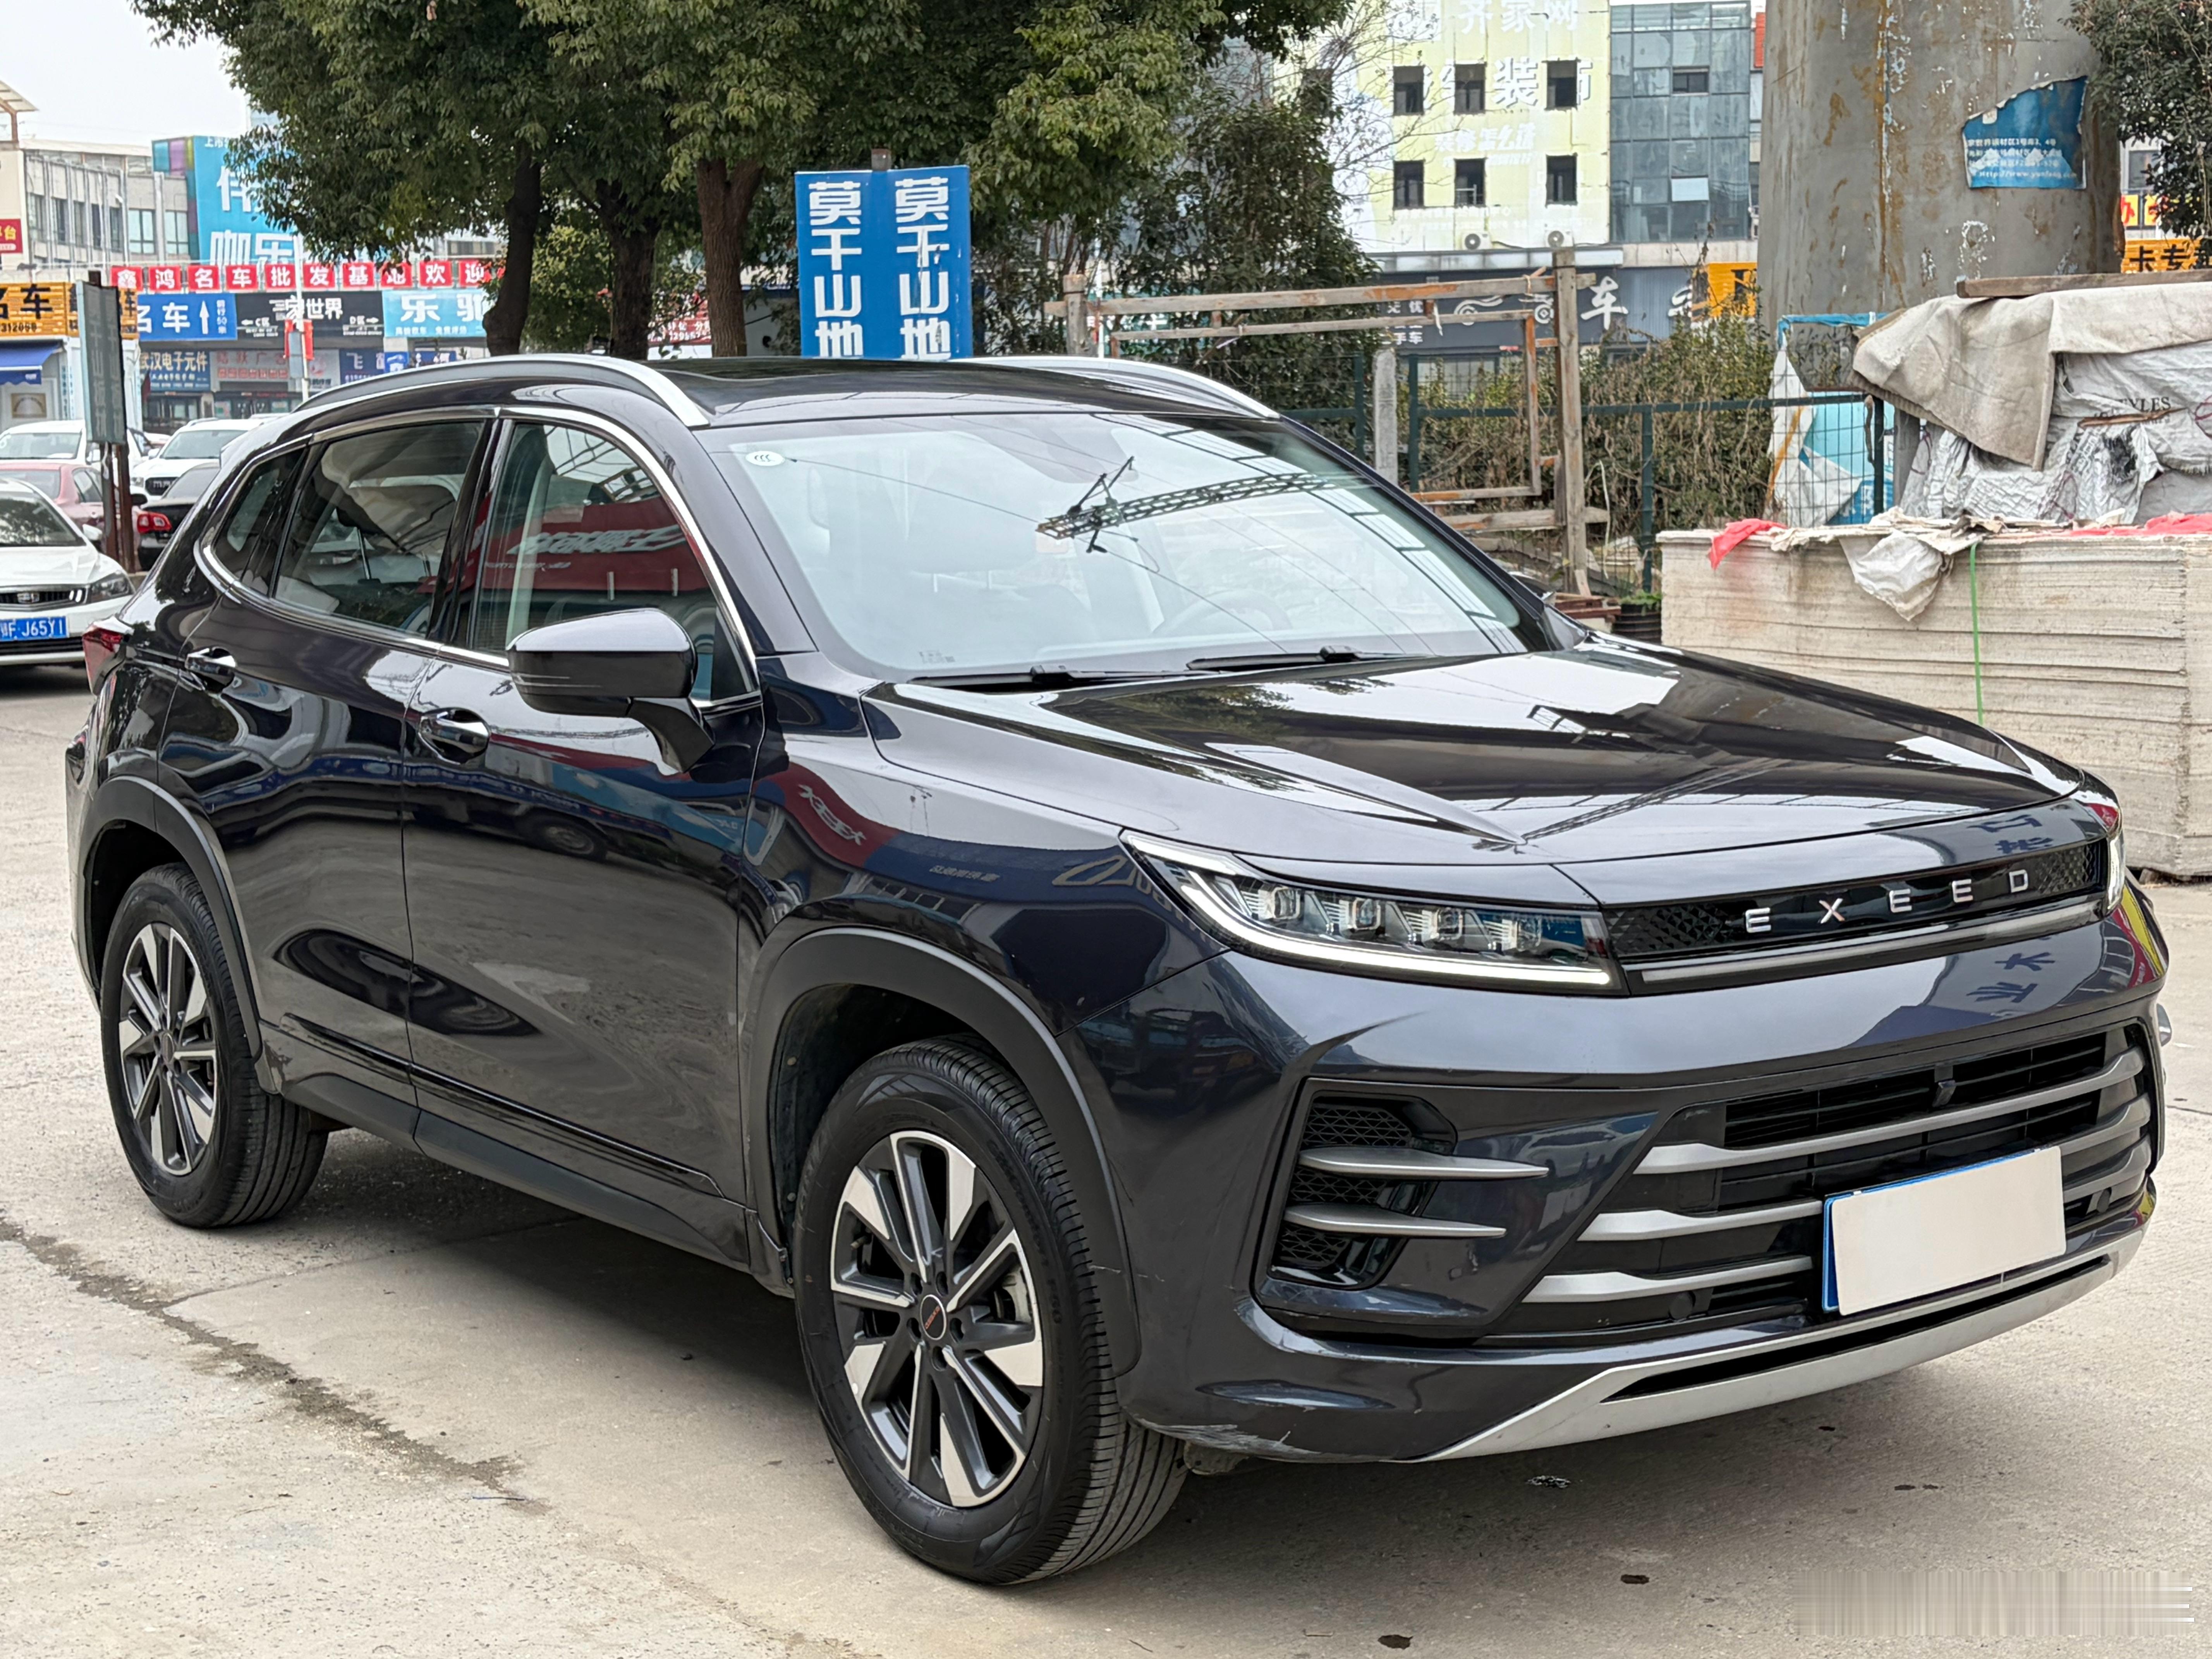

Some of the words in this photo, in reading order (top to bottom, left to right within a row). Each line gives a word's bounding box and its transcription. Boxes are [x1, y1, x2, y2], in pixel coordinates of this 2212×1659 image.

[895, 177, 951, 360] 莫干山地
[1745, 869, 2028, 934] EXEED
